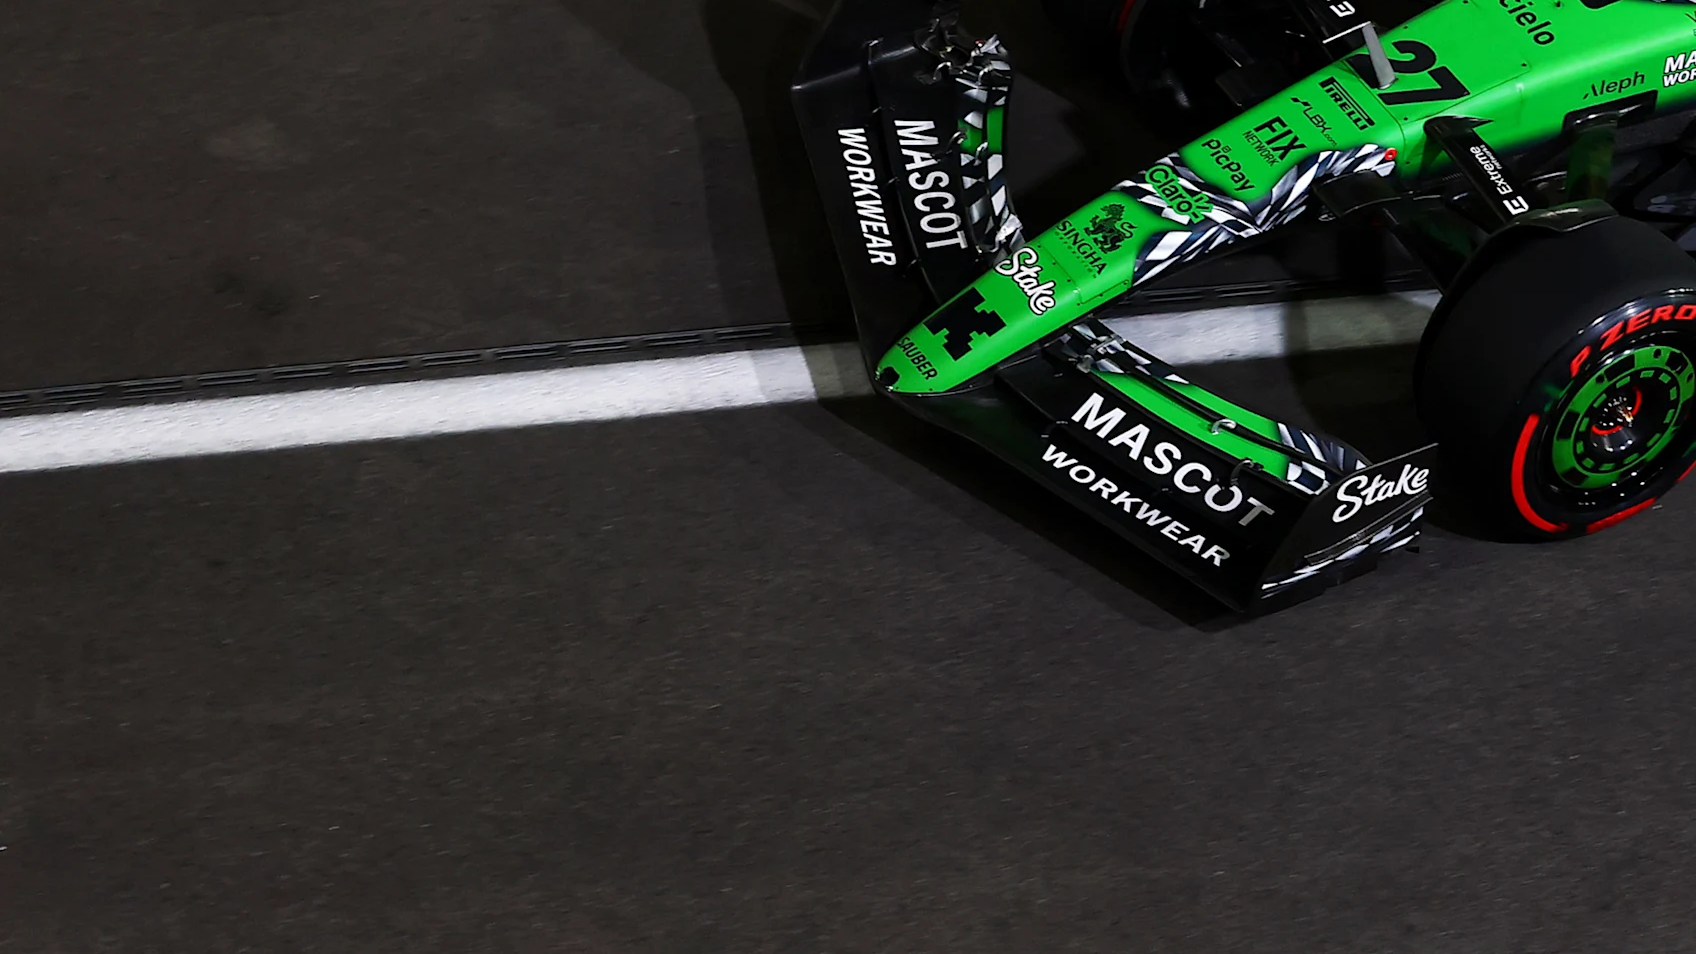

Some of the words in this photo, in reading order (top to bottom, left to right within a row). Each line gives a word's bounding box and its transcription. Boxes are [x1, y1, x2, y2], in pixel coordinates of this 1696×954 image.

[1345, 40, 1471, 106] 27
[1583, 71, 1646, 100] Aleph
[1318, 76, 1375, 131] PIRELLI
[1202, 138, 1256, 193] PicPay
[1242, 130, 1280, 167] NETWORK
[1253, 115, 1307, 161] FIX
[837, 128, 897, 266] WORKWEAR
[894, 119, 968, 250] MASCOT
[1148, 166, 1194, 214] Claro
[1469, 146, 1513, 195] Extreme
[1056, 220, 1108, 275] SINGHA
[995, 246, 1056, 315] Stake
[897, 336, 938, 381] SAUBER
[1569, 346, 1592, 378] P
[1071, 392, 1275, 527] MASCOT
[1041, 444, 1231, 568] WORKWEAR
[1332, 463, 1430, 523] Stake
